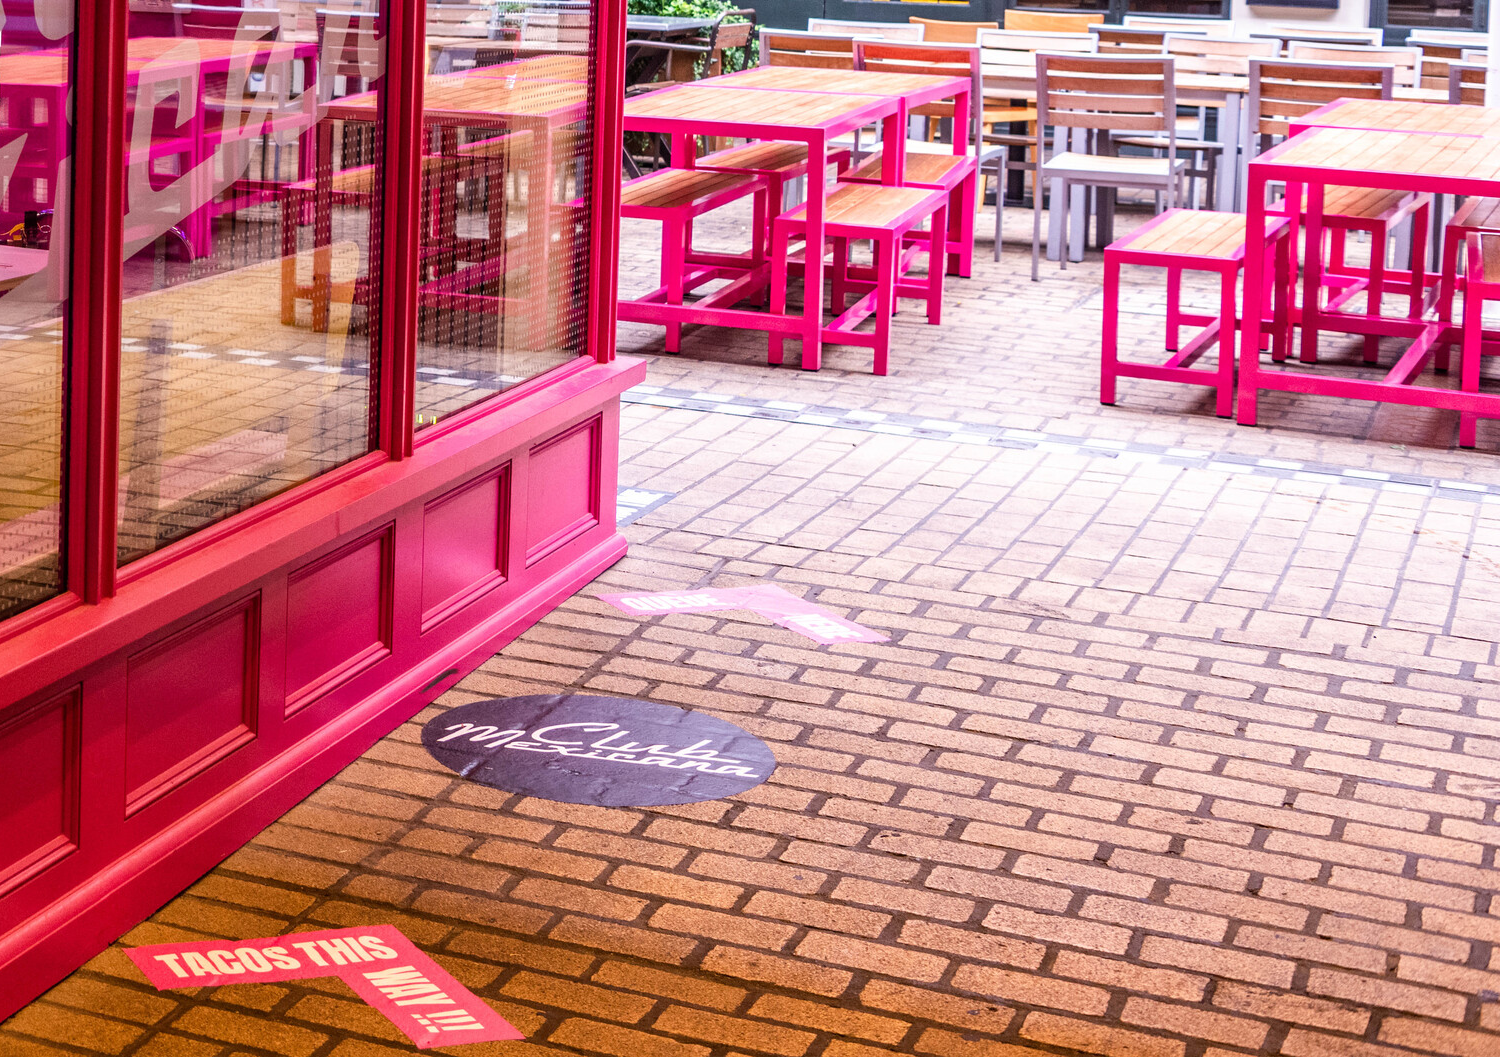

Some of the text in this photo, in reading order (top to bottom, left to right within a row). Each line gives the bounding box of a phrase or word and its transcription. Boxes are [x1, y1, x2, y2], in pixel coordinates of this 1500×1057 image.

[437, 723, 760, 778] Mexicana
[531, 722, 742, 764] Club
[153, 935, 399, 978] TACOS THIS
[363, 965, 456, 1006] WAY
